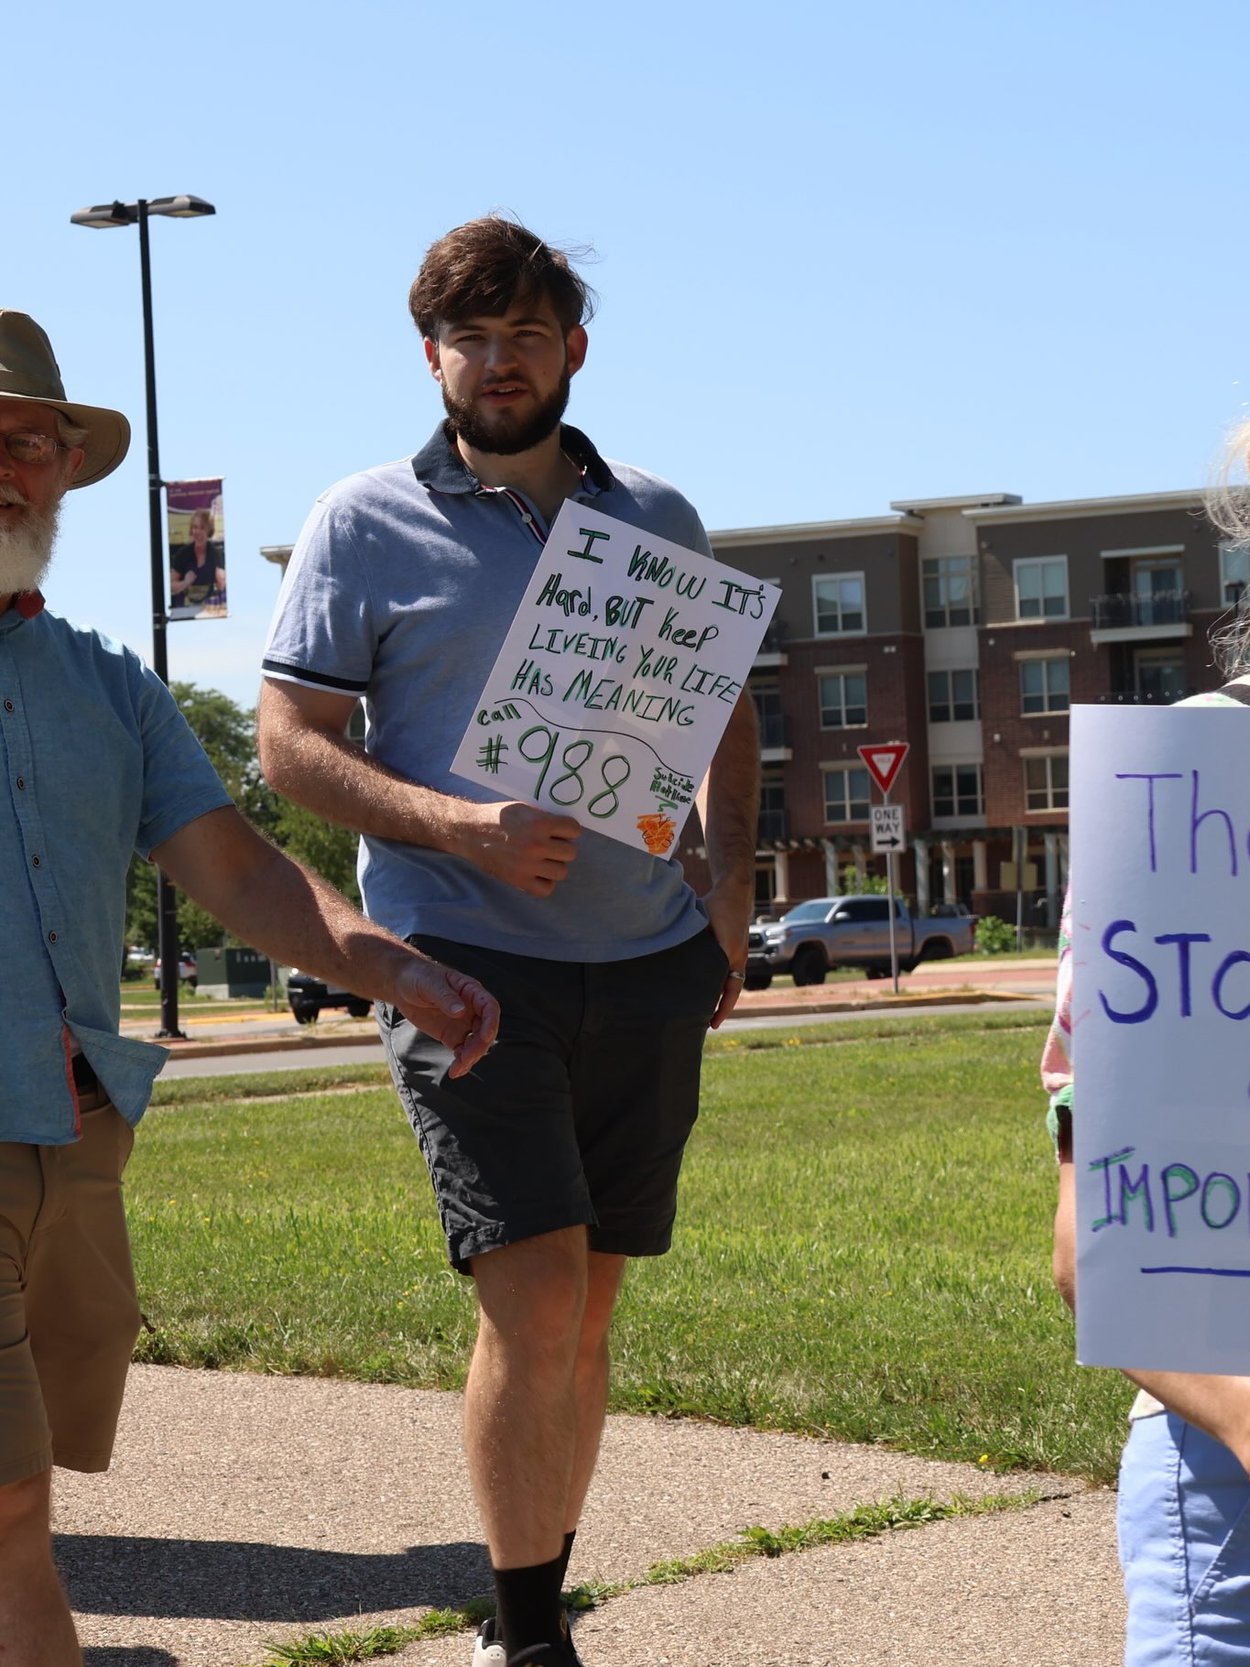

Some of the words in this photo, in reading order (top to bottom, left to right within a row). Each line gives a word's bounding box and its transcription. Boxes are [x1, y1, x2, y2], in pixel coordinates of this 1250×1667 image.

[567, 527, 610, 563] I
[627, 545, 706, 600] KNOW
[605, 595, 655, 629] BUT
[528, 623, 627, 664] LIVEING
[680, 663, 743, 704] LIFE
[510, 658, 554, 697] HAS
[562, 669, 696, 727] MEANING
[477, 703, 522, 727] call
[874, 809, 900, 821] ONE
[875, 823, 900, 834] WAY
